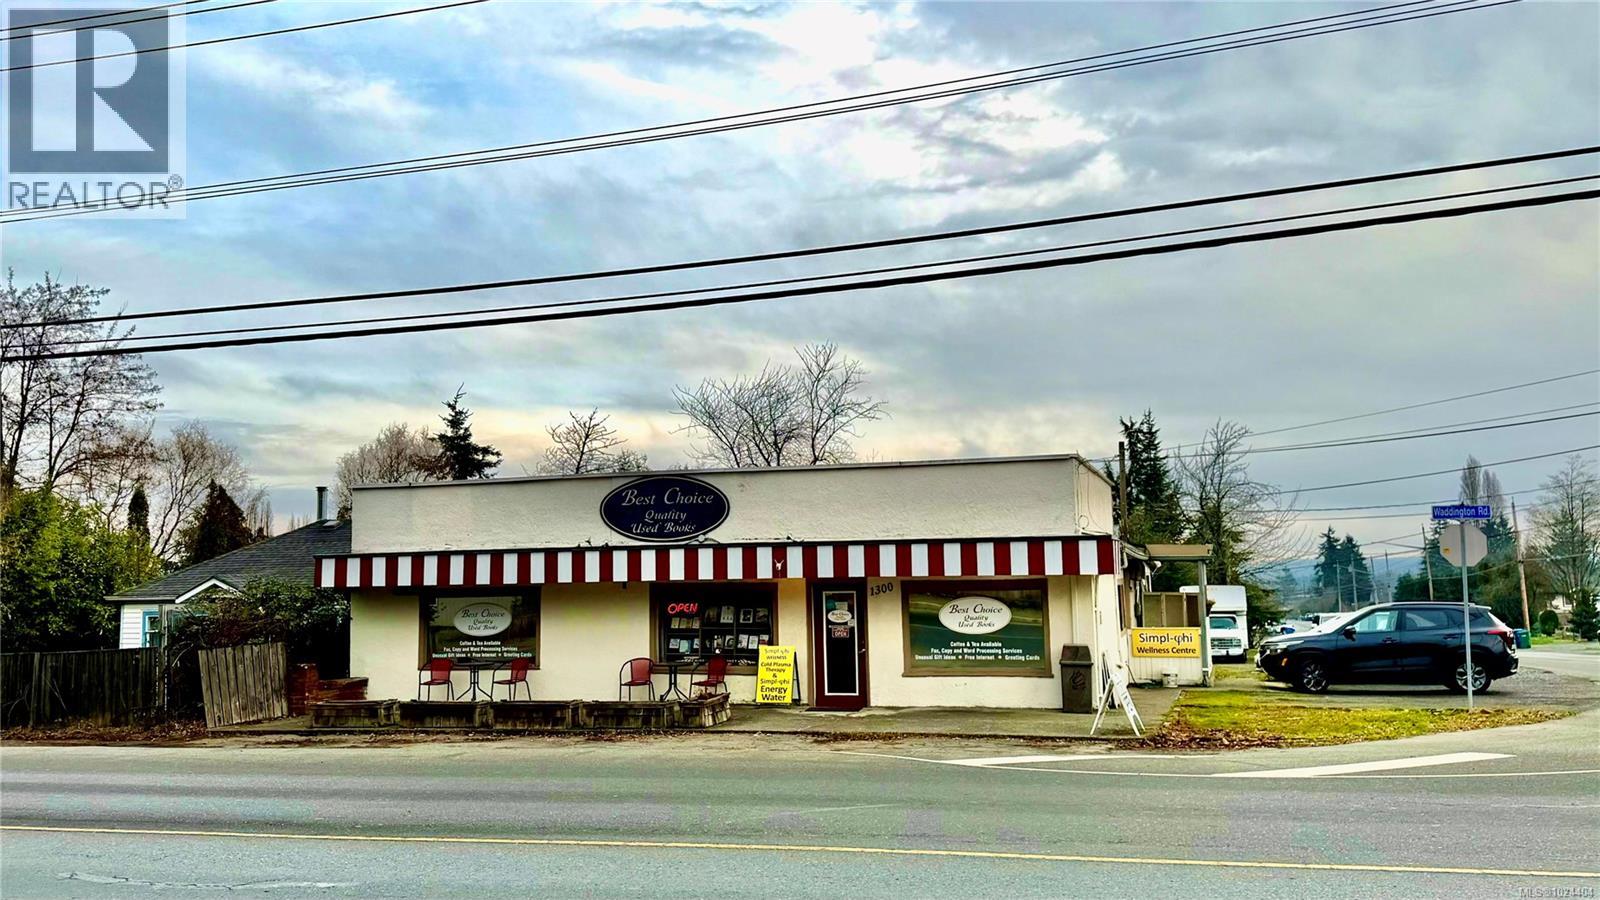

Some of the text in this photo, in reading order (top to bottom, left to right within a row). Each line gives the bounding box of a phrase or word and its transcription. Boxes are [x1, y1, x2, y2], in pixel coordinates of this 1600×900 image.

[622, 487, 714, 506] Best Choice
[644, 509, 687, 523] Quality
[1434, 506, 1490, 518] Waddington Rd.
[631, 522, 696, 533] Used Books
[870, 582, 894, 596] 1300
[461, 608, 505, 618] Best Choice
[667, 603, 698, 614] OPEN
[949, 604, 1003, 614] Best Choice
[761, 686, 788, 694] Energy
